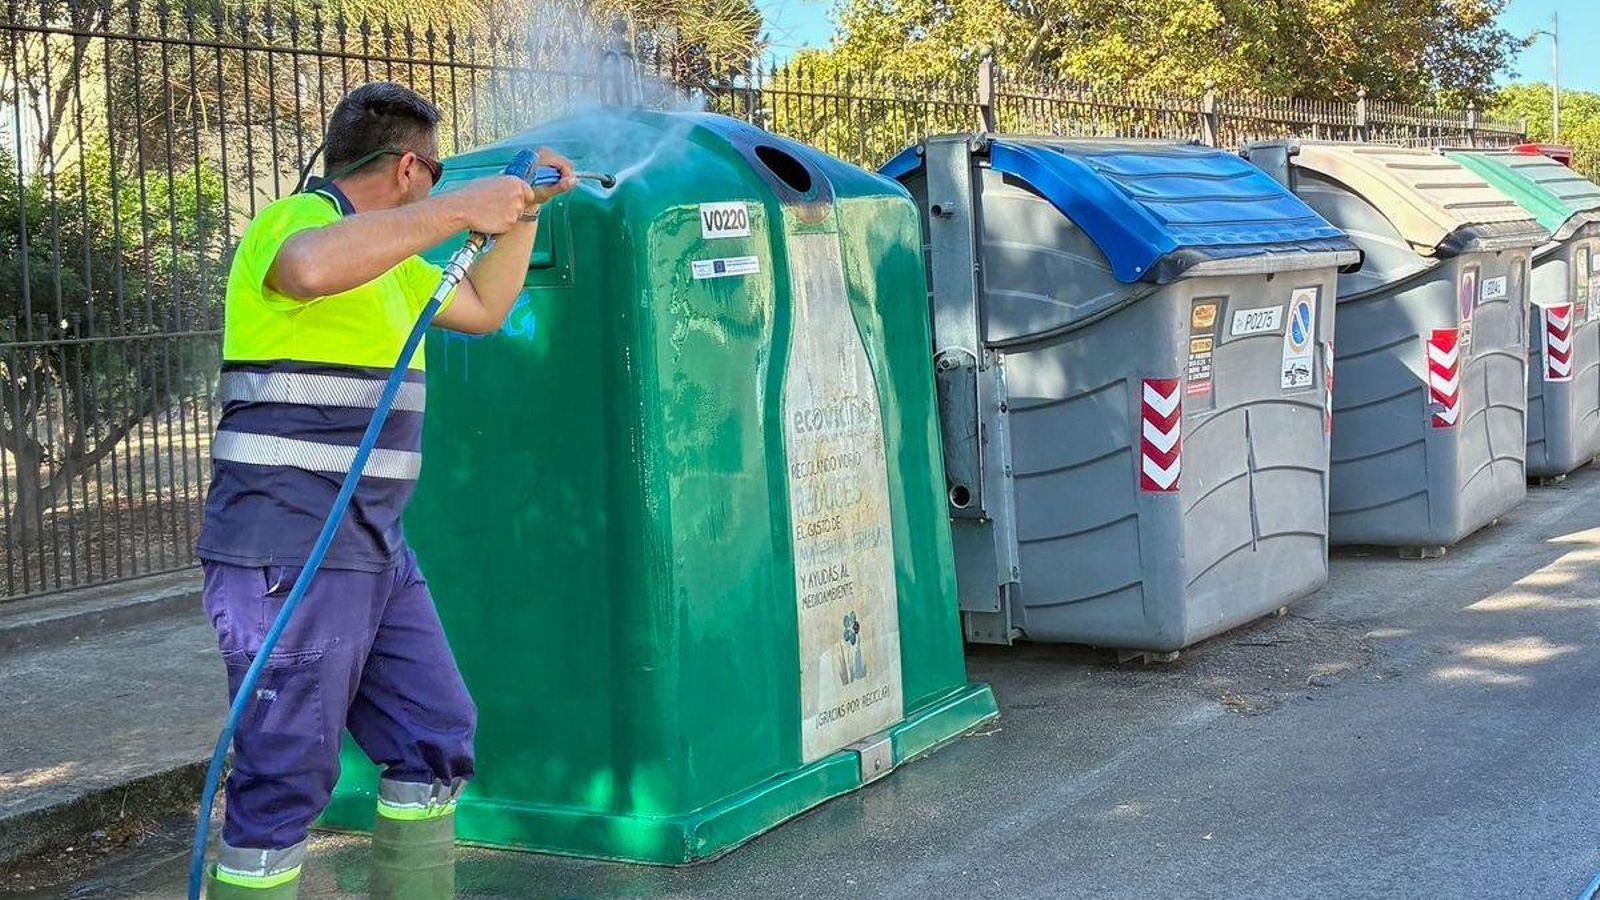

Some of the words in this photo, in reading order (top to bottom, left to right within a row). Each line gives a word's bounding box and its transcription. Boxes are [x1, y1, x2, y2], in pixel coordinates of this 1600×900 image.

[1244, 310, 1274, 330] P0275
[796, 525, 806, 540] EL
[831, 515, 841, 531] DE
[800, 574, 806, 590] Y
[808, 565, 840, 589] AYUDAS
[840, 562, 850, 578] AL
